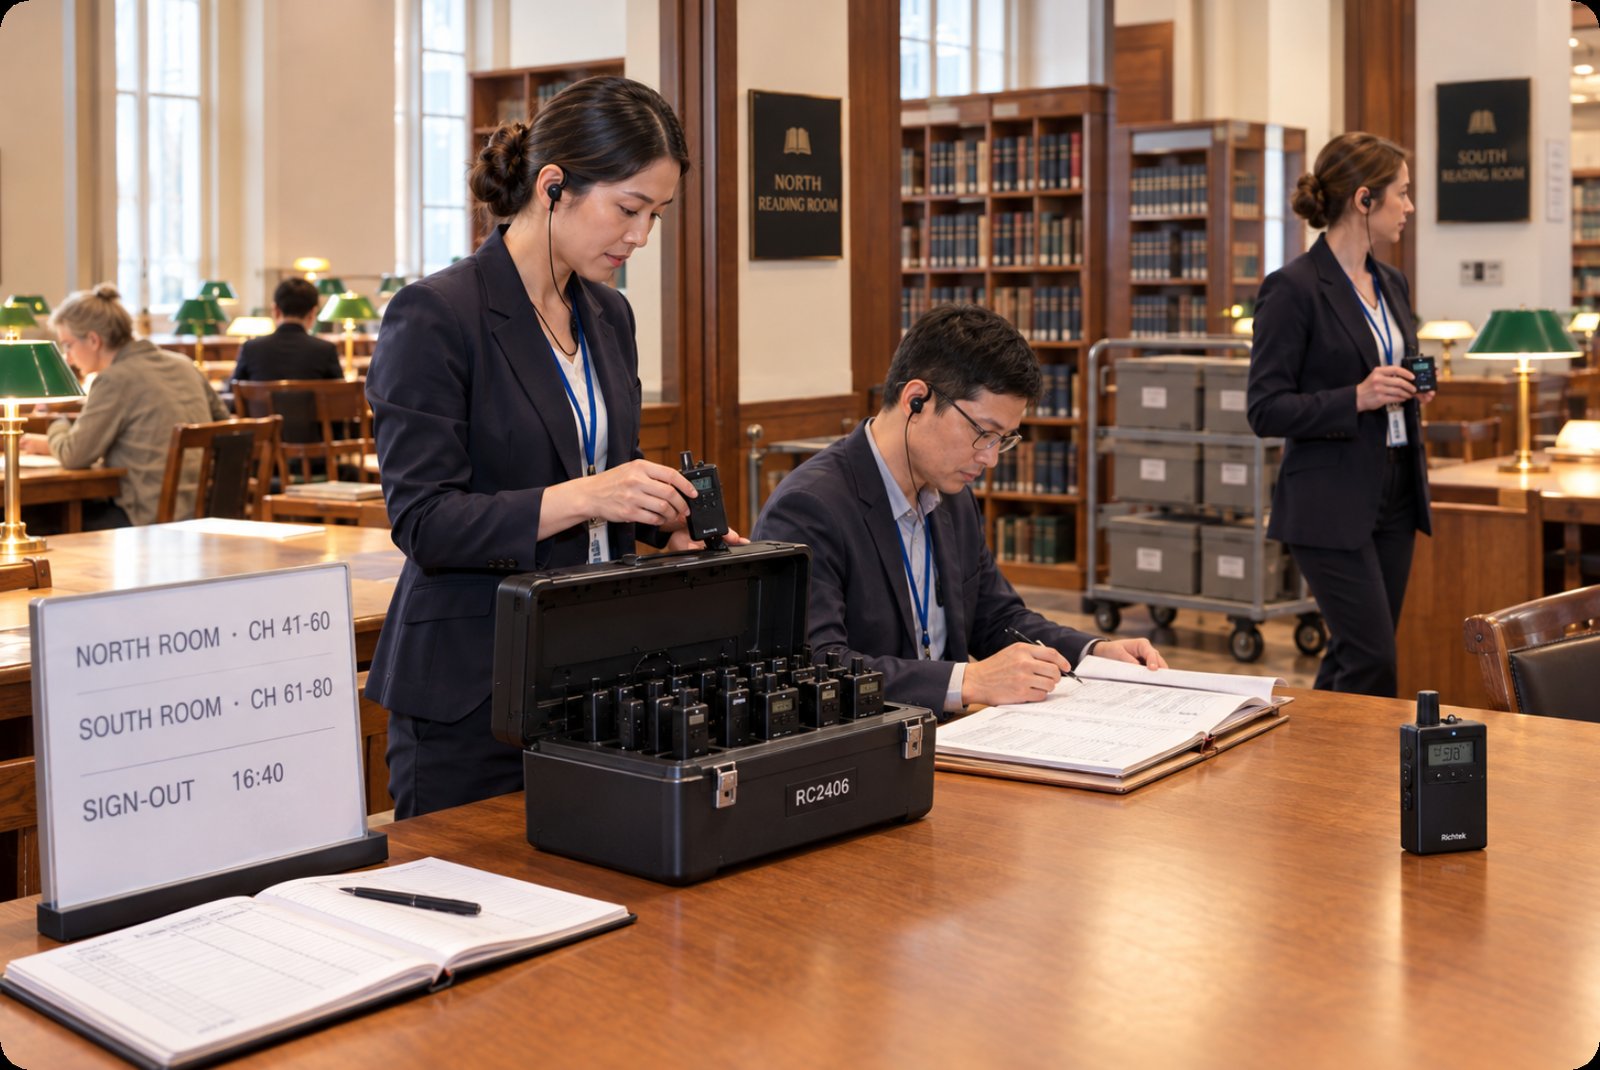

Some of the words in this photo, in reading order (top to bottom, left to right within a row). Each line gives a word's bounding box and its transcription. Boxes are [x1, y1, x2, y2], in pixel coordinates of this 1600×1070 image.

[1458, 149, 1507, 165] SOUTH
[775, 174, 822, 191] NORTH
[758, 196, 805, 211] READING
[807, 198, 839, 212] ROOM
[76, 636, 150, 668] NORTH
[159, 626, 221, 656] ROOM
[248, 618, 275, 641] CH
[281, 610, 331, 636] 41-60
[79, 707, 152, 740] SOUTH
[160, 696, 222, 726] ROOM
[250, 686, 277, 709] CH
[283, 676, 333, 704] 61-80
[82, 779, 195, 823] SIGN-OUT
[232, 762, 284, 791] 16:40
[795, 777, 850, 807] RC2406
